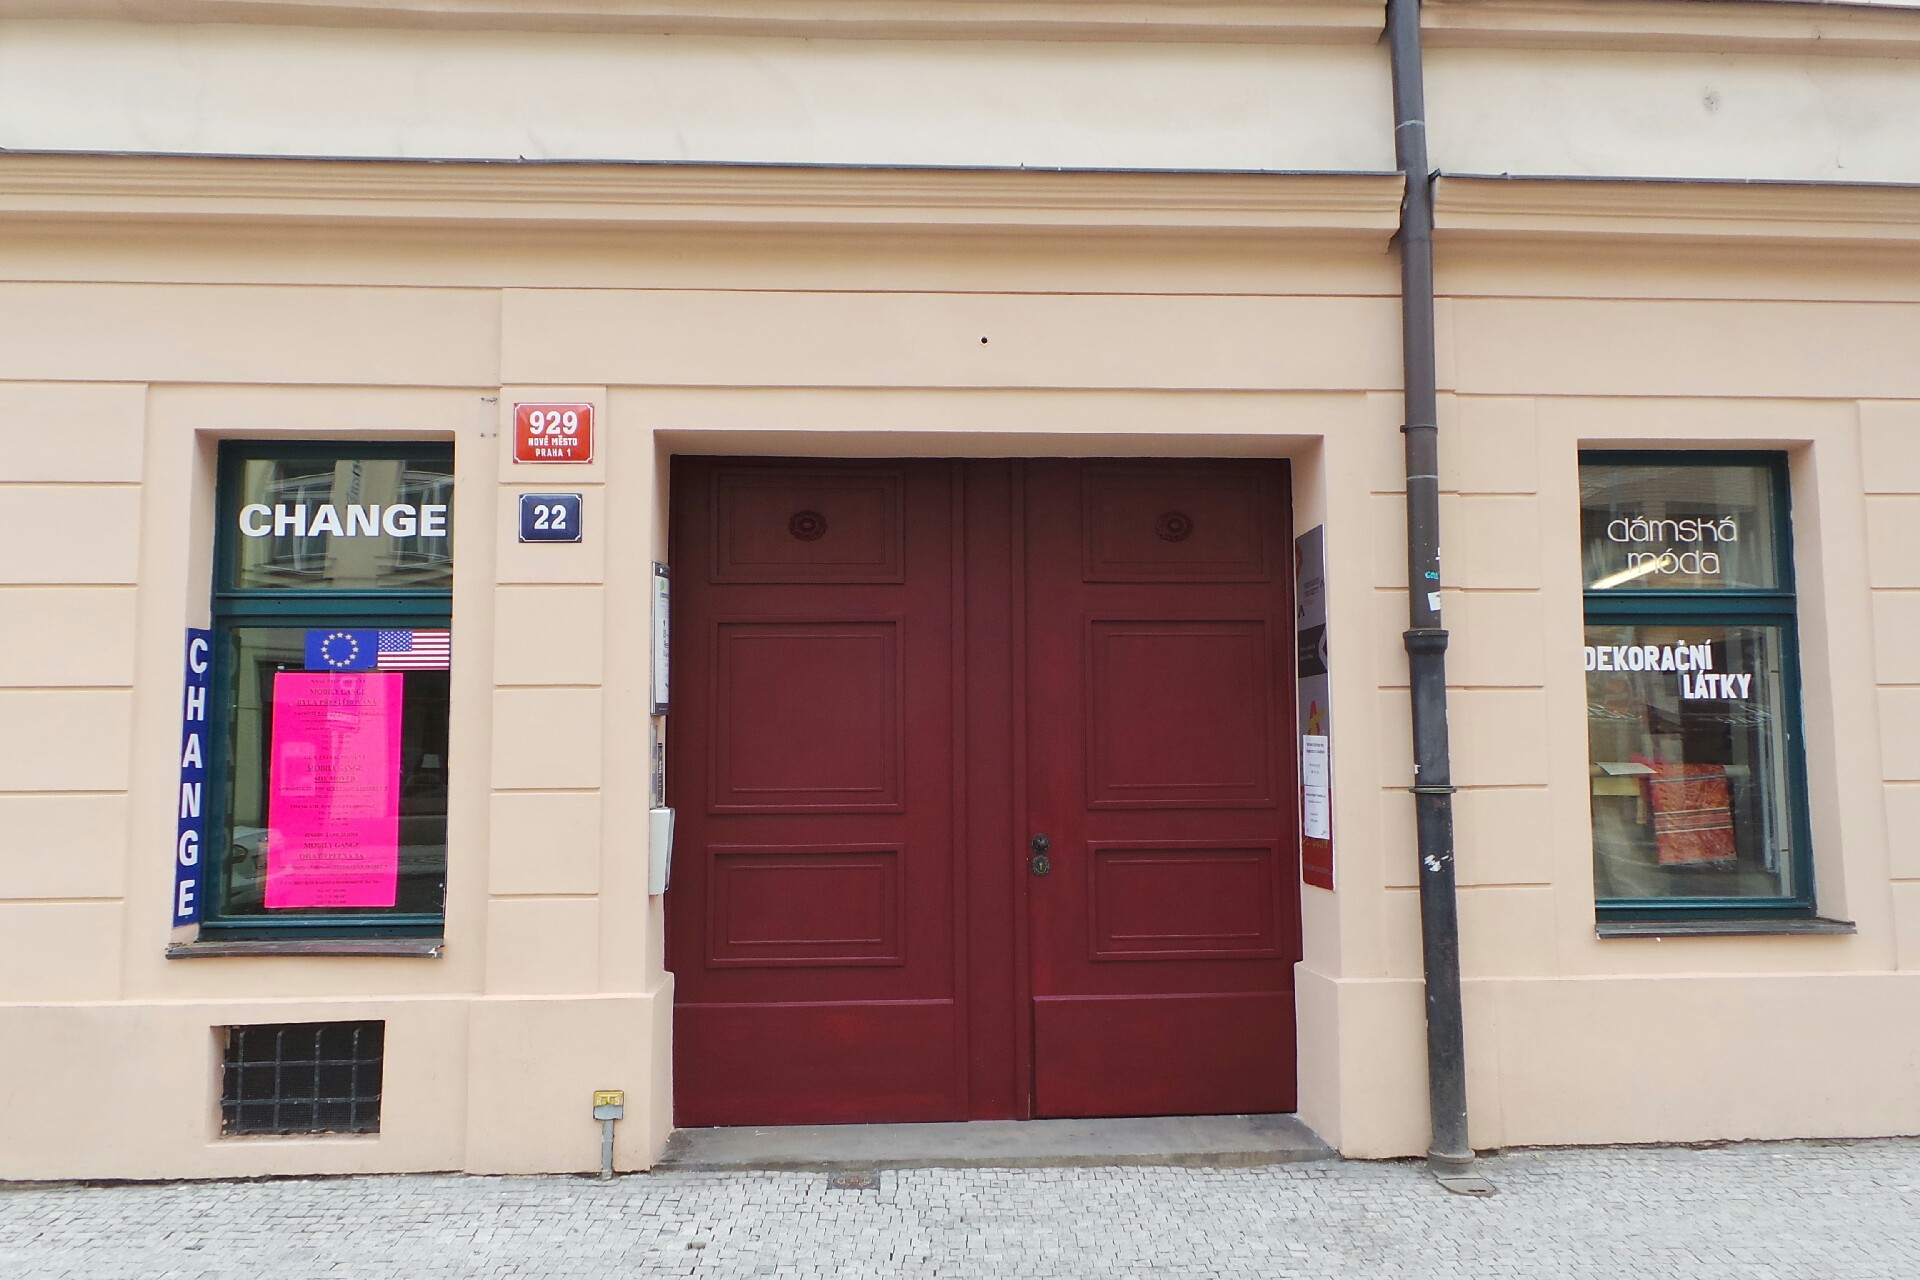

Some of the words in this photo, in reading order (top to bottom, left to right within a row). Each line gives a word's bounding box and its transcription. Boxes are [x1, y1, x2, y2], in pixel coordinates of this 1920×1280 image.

[529, 410, 578, 435] 929
[528, 435, 549, 446] NOVÉ
[551, 434, 578, 446] MĚSTO
[535, 448, 564, 457] PRAHA
[566, 448, 572, 457] 1
[239, 503, 447, 537] CHANGE
[533, 504, 567, 530] 22
[1607, 515, 1738, 542] dámská
[1627, 547, 1721, 574] móda
[1584, 639, 1713, 671] DEKORAČNÍ
[1683, 670, 1752, 699] LÁTKY
[177, 637, 208, 917] CHANGE
